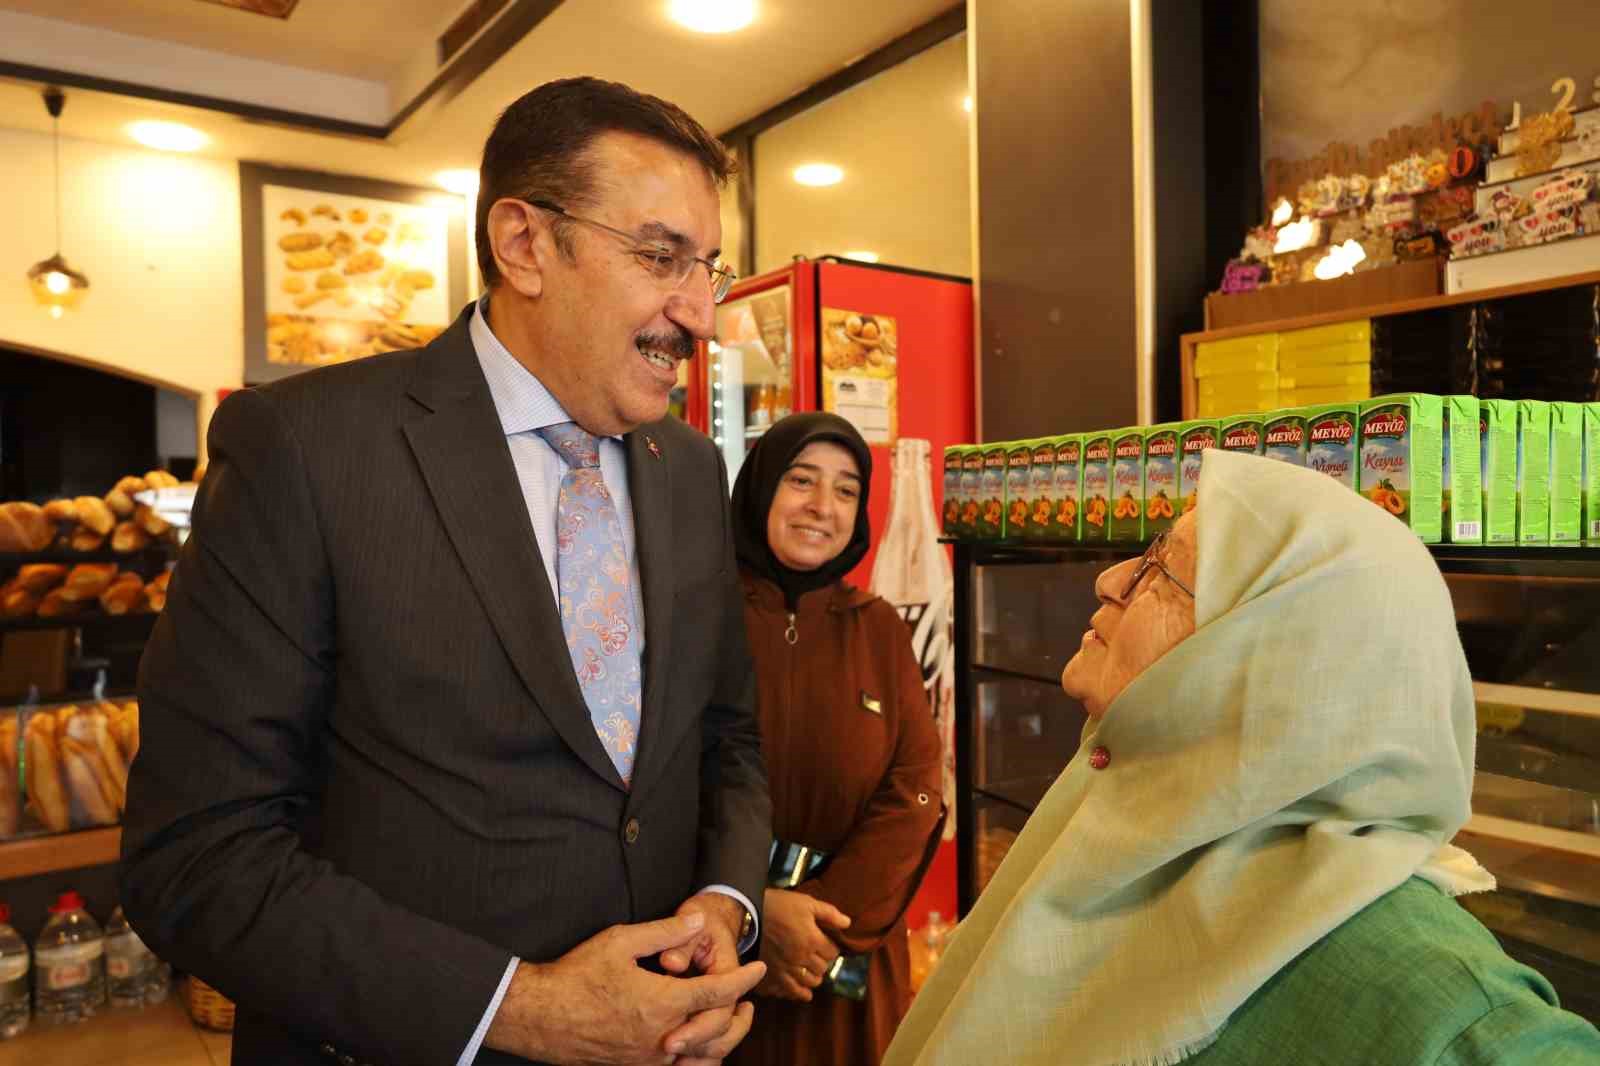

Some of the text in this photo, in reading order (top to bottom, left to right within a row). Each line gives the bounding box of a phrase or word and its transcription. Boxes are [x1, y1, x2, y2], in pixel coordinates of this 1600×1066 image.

[1312, 425, 1351, 440] MEYÖZ
[1364, 418, 1404, 434] MEYÖZ
[1224, 434, 1257, 447] MEYÖZ
[1266, 430, 1302, 443] MEYÖZ
